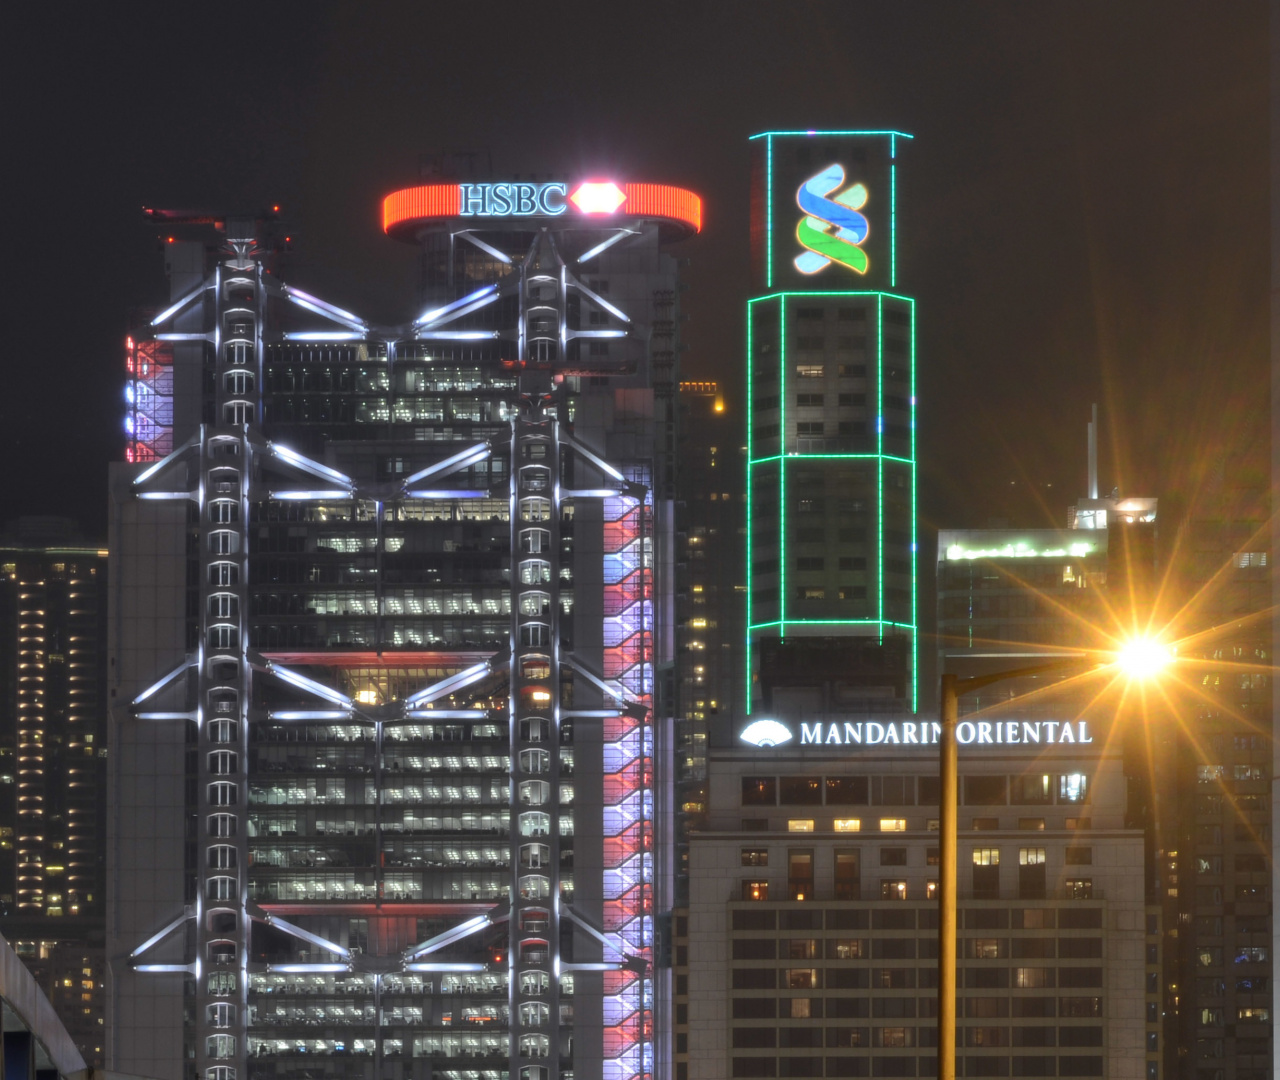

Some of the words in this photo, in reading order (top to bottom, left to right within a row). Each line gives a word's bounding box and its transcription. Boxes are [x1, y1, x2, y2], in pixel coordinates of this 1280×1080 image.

[459, 182, 567, 216] HSBC
[800, 721, 941, 744] MANDARIN
[956, 721, 1093, 744] ORIENTAL
